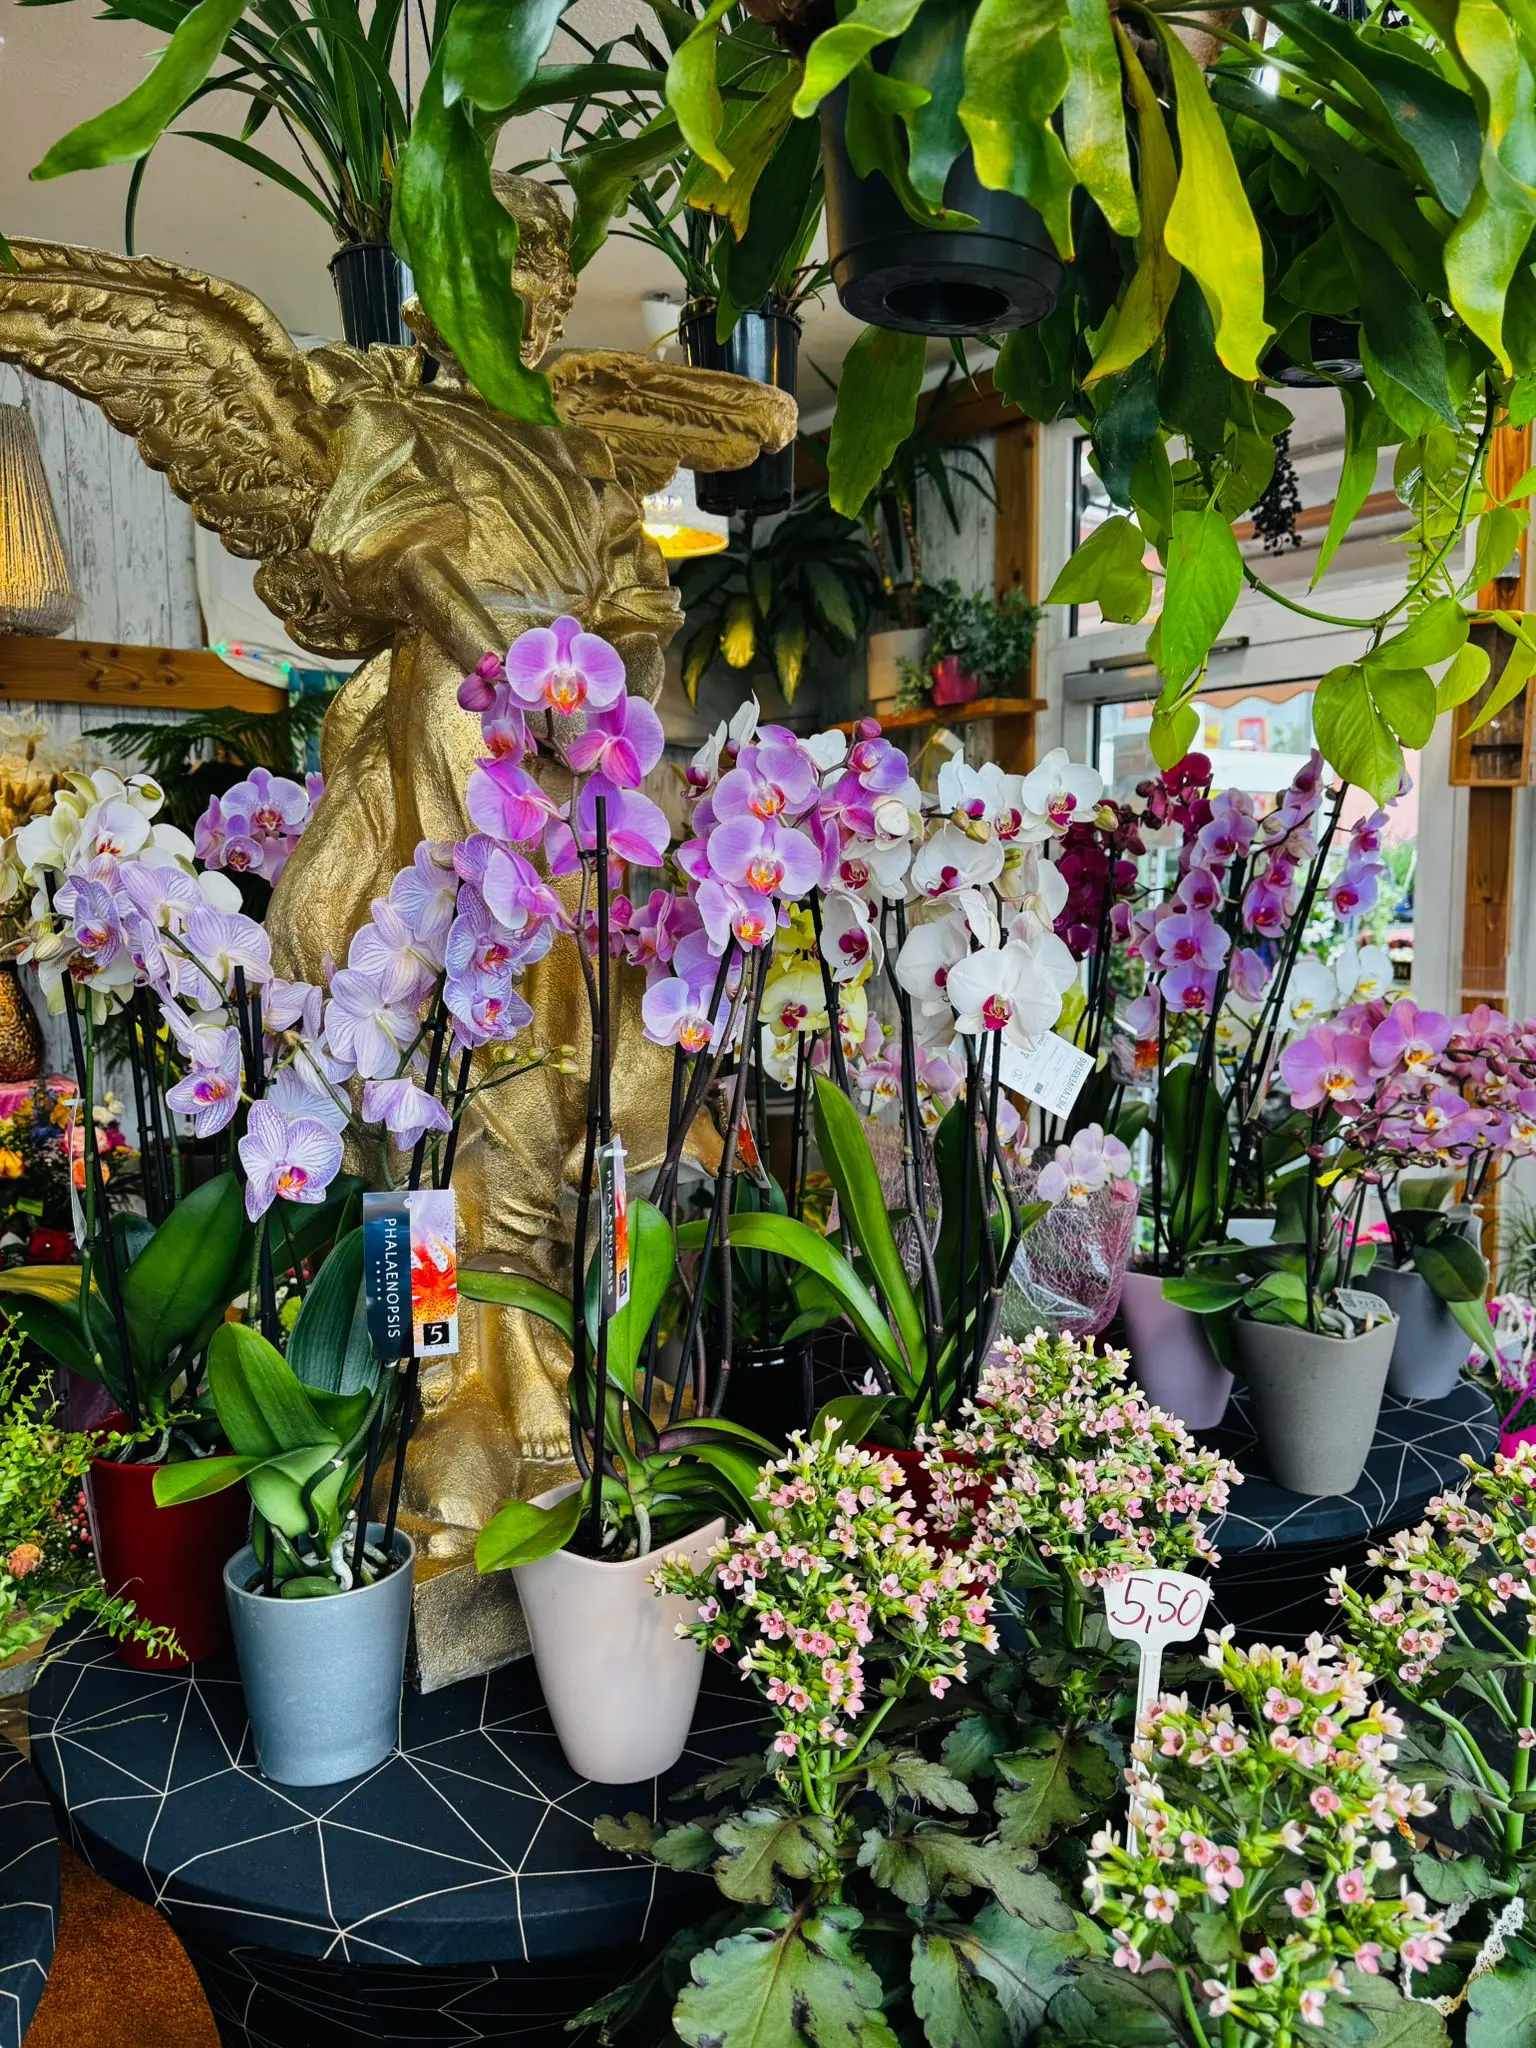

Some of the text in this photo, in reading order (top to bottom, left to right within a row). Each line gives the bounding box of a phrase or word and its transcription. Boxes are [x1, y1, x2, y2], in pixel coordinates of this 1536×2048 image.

[384, 1218, 400, 1337] PHALAENOPSIS
[606, 1171, 614, 1295] PHALAENOPSIS
[1110, 1577, 1203, 1634] 5,50
